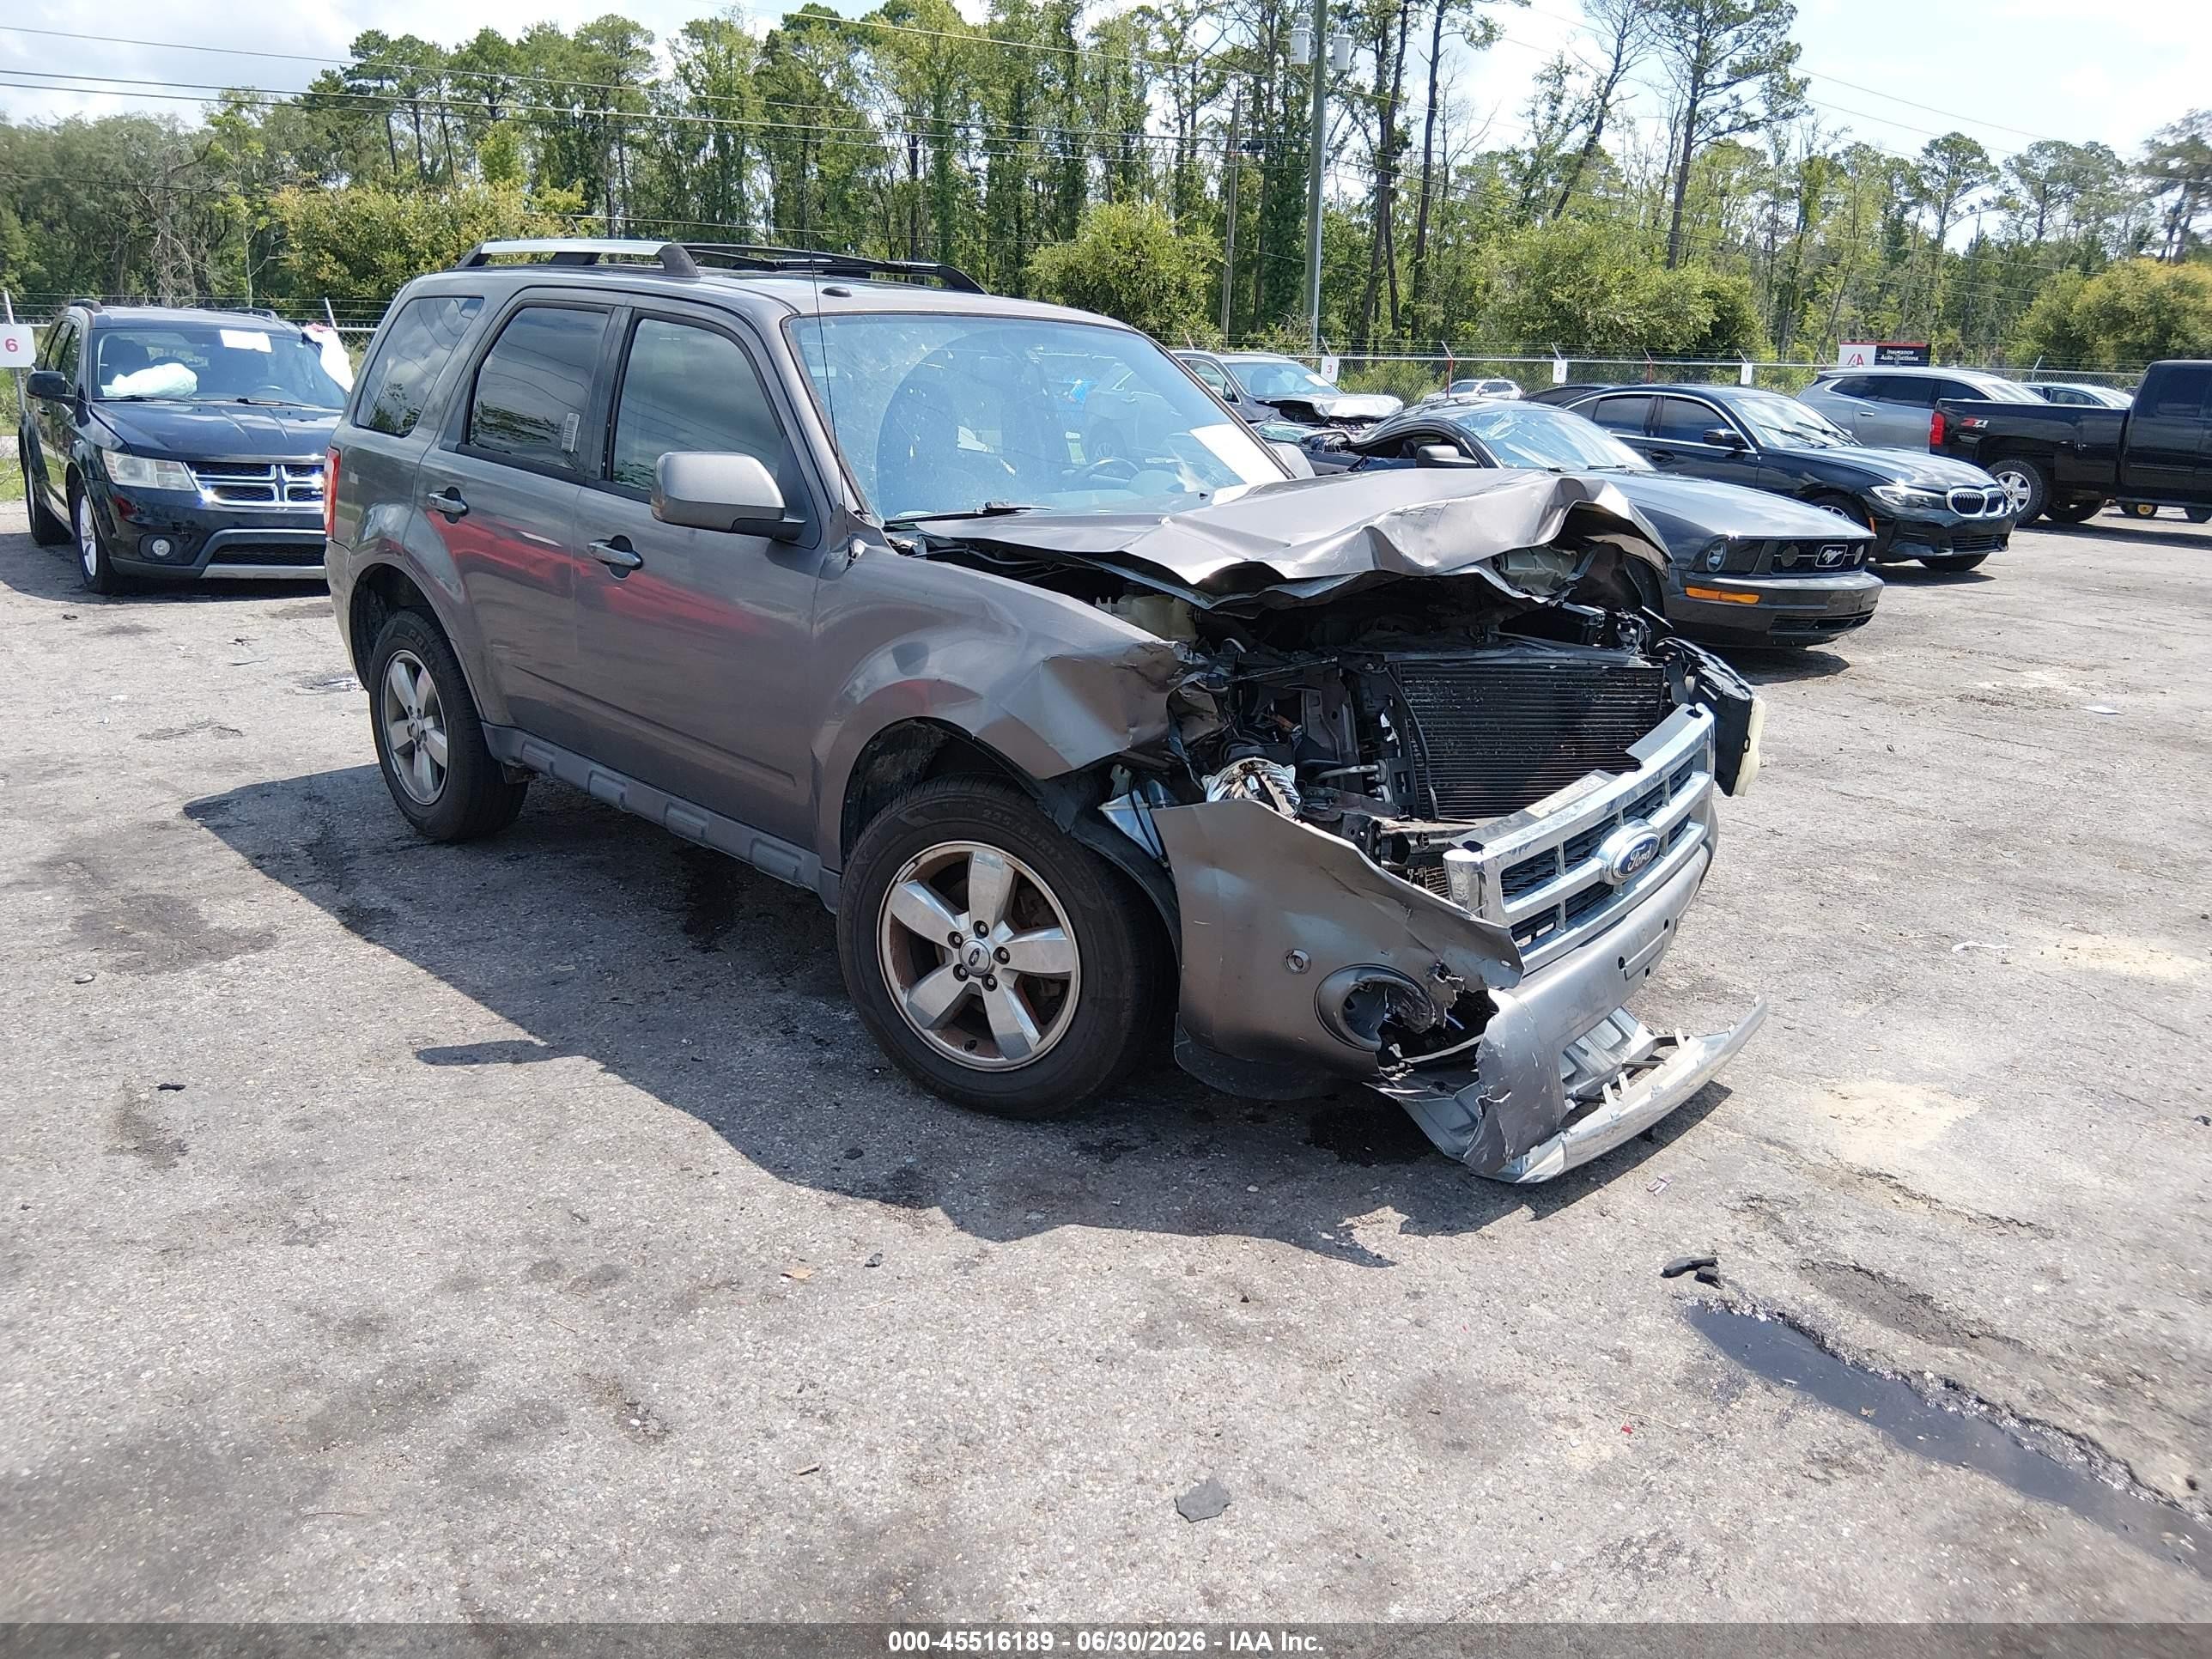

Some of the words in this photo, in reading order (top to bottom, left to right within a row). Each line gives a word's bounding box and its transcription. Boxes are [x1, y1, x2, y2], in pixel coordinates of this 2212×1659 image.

[5, 338, 18, 352] 6
[1327, 364, 1333, 374] 3
[1627, 843, 1653, 872] Ford
